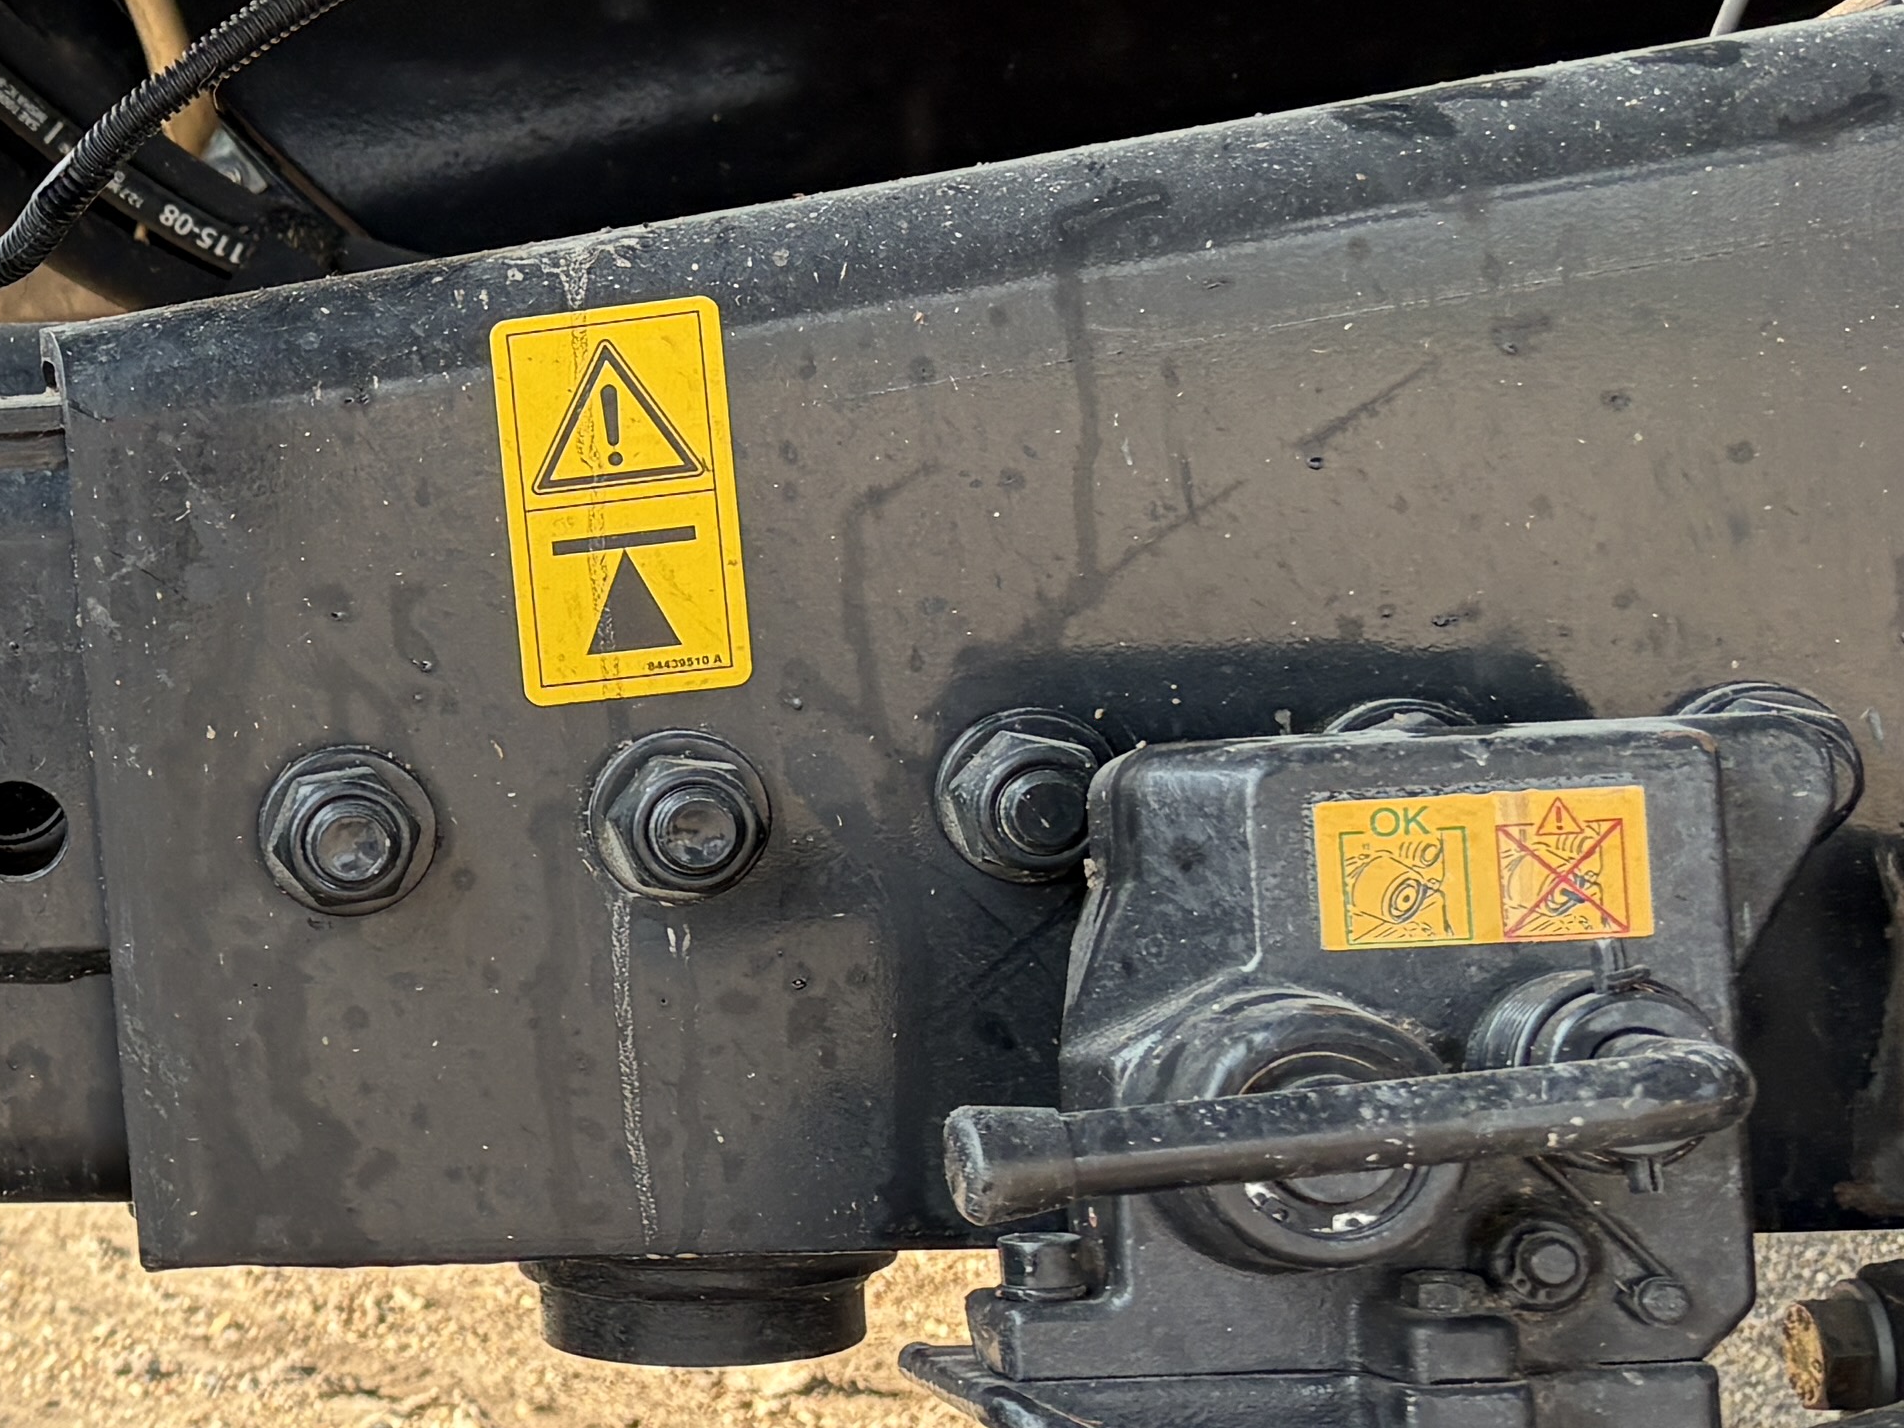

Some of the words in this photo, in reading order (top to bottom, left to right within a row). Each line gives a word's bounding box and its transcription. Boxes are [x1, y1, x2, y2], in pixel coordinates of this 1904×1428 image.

[158, 202, 247, 265] 115-08
[714, 654, 722, 664] A
[1370, 805, 1432, 838] OK
